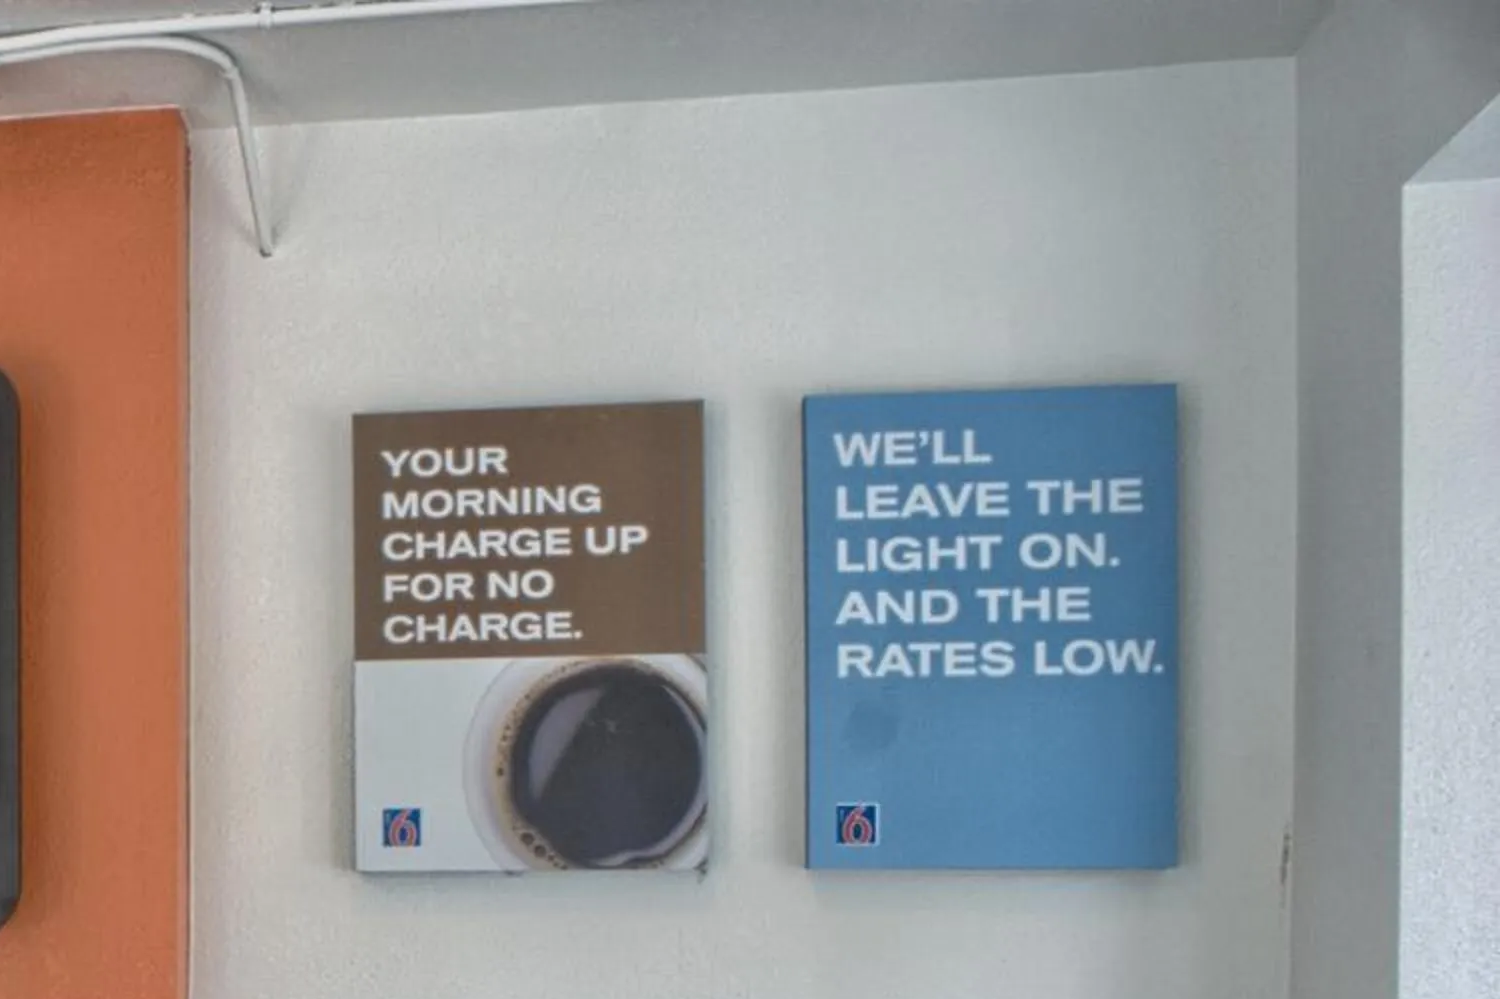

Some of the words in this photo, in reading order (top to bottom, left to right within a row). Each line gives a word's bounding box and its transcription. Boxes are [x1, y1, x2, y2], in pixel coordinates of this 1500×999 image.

[380, 445, 510, 480] YOUR
[833, 428, 993, 469] WE'LL
[382, 483, 603, 521] MORNING
[835, 480, 1011, 522] LEAVE
[1027, 476, 1145, 516] THE
[382, 524, 573, 564] CHARGE
[584, 523, 650, 556] UP
[835, 534, 1002, 574] LIGHT
[1019, 532, 1122, 569] ON.
[383, 572, 475, 605] FOR
[485, 568, 555, 600] NO
[835, 587, 960, 626] AND
[975, 584, 1092, 623] THE
[382, 610, 583, 645] CHARGE.
[836, 640, 1016, 680] RATES
[1033, 637, 1164, 676] LOW.
